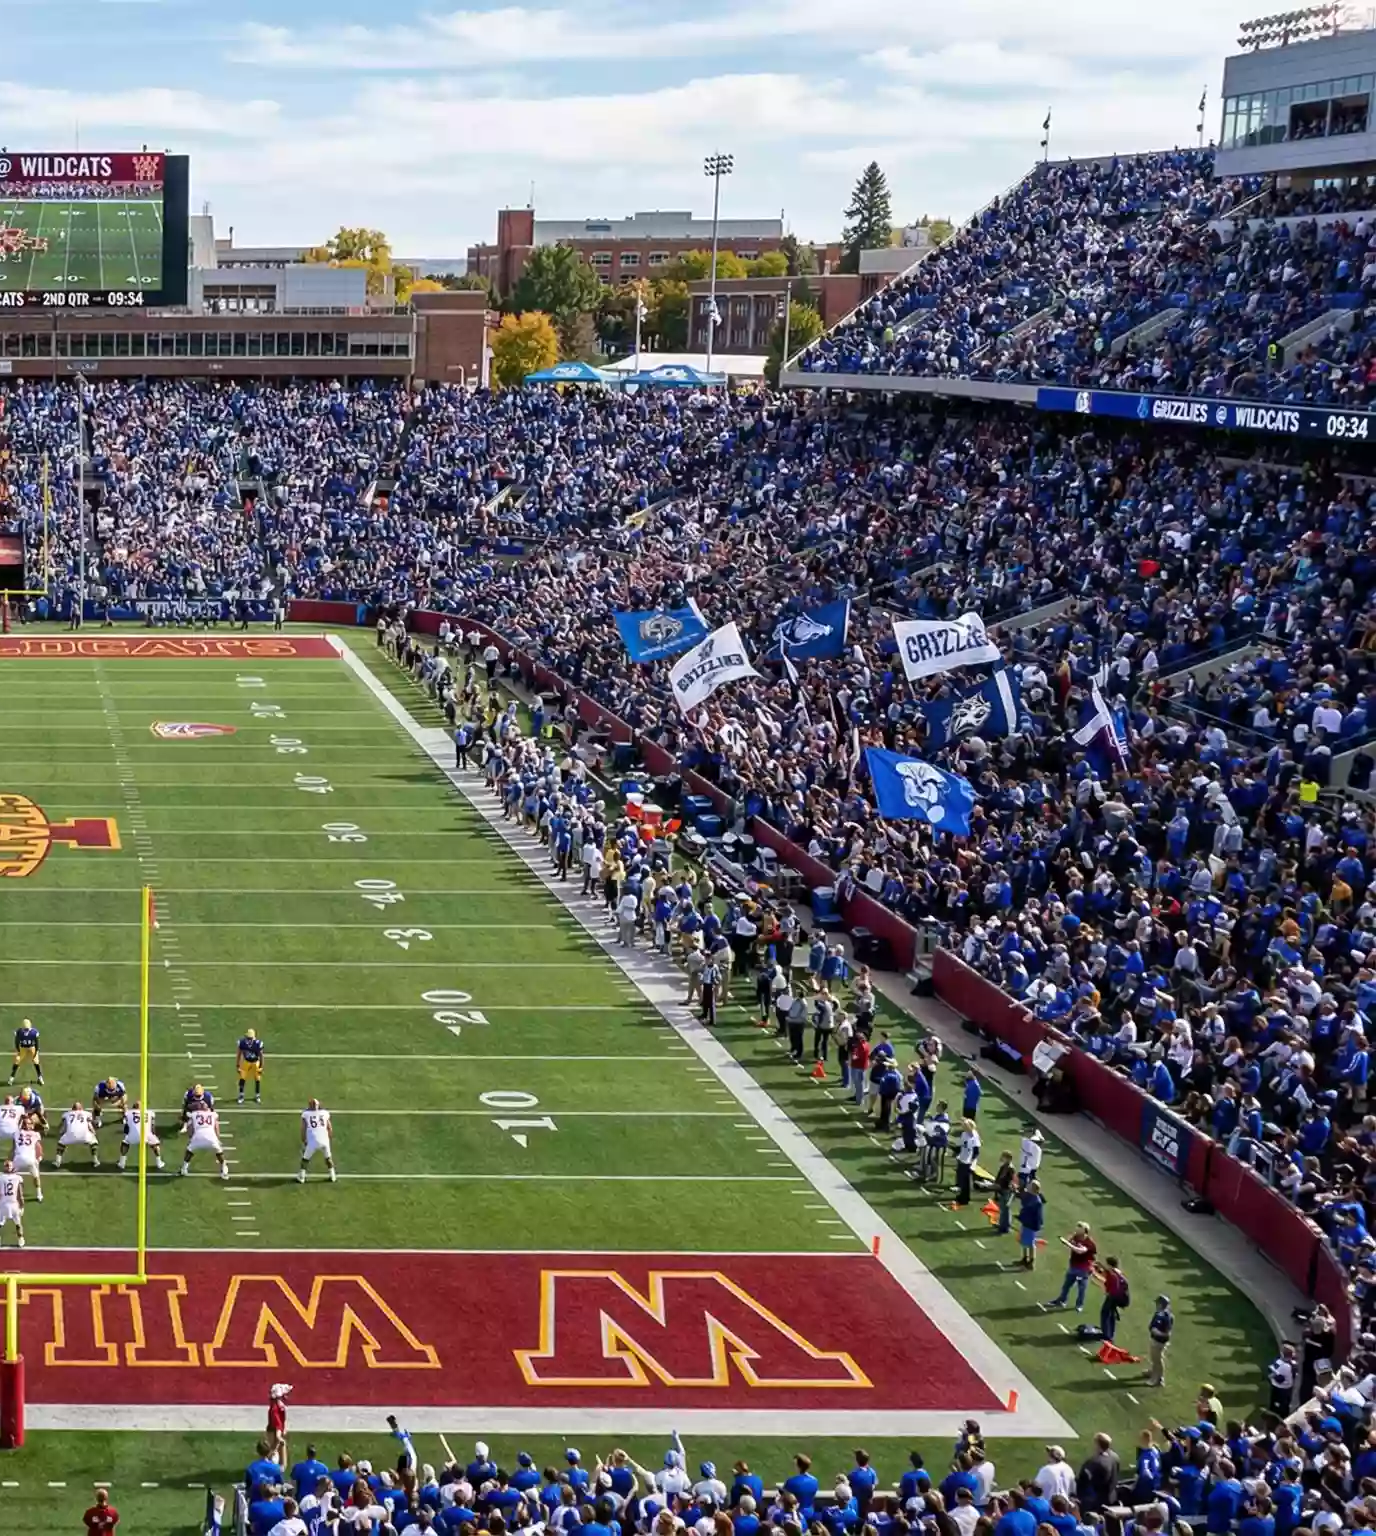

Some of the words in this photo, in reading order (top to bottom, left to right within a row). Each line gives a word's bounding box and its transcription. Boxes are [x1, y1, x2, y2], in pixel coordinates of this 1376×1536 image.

[21, 157, 113, 177] WILDCATS
[43, 292, 65, 306] 2ND
[68, 292, 90, 307] QTR
[1152, 399, 1208, 423] GRIZZLIES
[1235, 407, 1300, 433] WILDCATS
[1326, 415, 1369, 439] 09:34
[321, 822, 368, 844] 50
[353, 879, 406, 904] 40
[420, 989, 491, 1025] 20
[479, 1090, 559, 1132] 10
[512, 1269, 874, 1389] W
